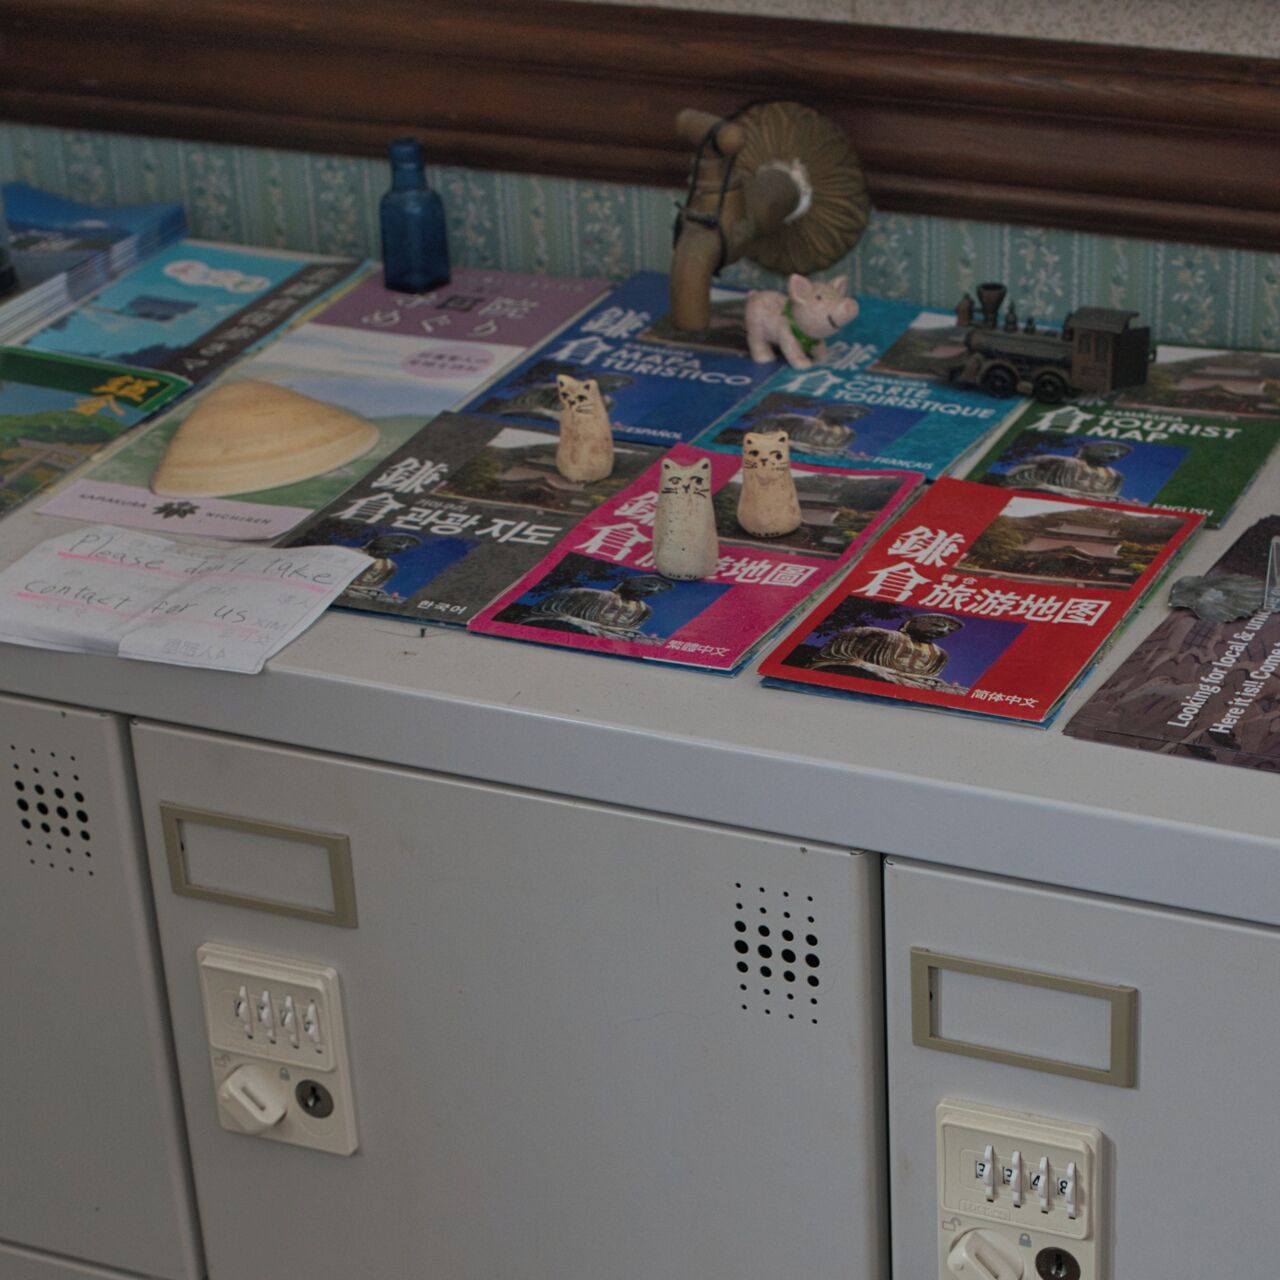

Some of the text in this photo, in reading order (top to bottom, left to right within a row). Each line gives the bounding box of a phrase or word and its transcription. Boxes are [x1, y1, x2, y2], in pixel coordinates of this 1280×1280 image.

[609, 348, 701, 370] MAPA
[844, 381, 932, 398] CARTE
[834, 391, 997, 418] TOURISTIQUE
[1104, 409, 1183, 423] KAMAKURA
[1086, 426, 1169, 443] MAP
[1097, 416, 1242, 439] TOURIST
[873, 456, 934, 470] FRANÇAIS
[329, 456, 448, 524] 鎌倉
[1152, 503, 1214, 517] ENGLISH
[391, 506, 563, 545] 관광 지도
[69, 534, 165, 571] Please
[262, 558, 333, 586] take
[852, 525, 966, 603] 鎌倉
[24, 579, 132, 610] contact
[151, 601, 199, 615] for
[214, 605, 248, 623] us
[417, 599, 469, 616] 한국어
[919, 582, 1113, 627] 旅游地图
[1233, 629, 1256, 643] &
[1212, 640, 1249, 669] local
[1201, 665, 1229, 686] for
[970, 688, 1040, 709] 简体中文
[1235, 678, 1265, 700] is!!
[1167, 684, 1222, 728] Looking
[1228, 694, 1252, 709] it
[1208, 705, 1246, 735] Here
